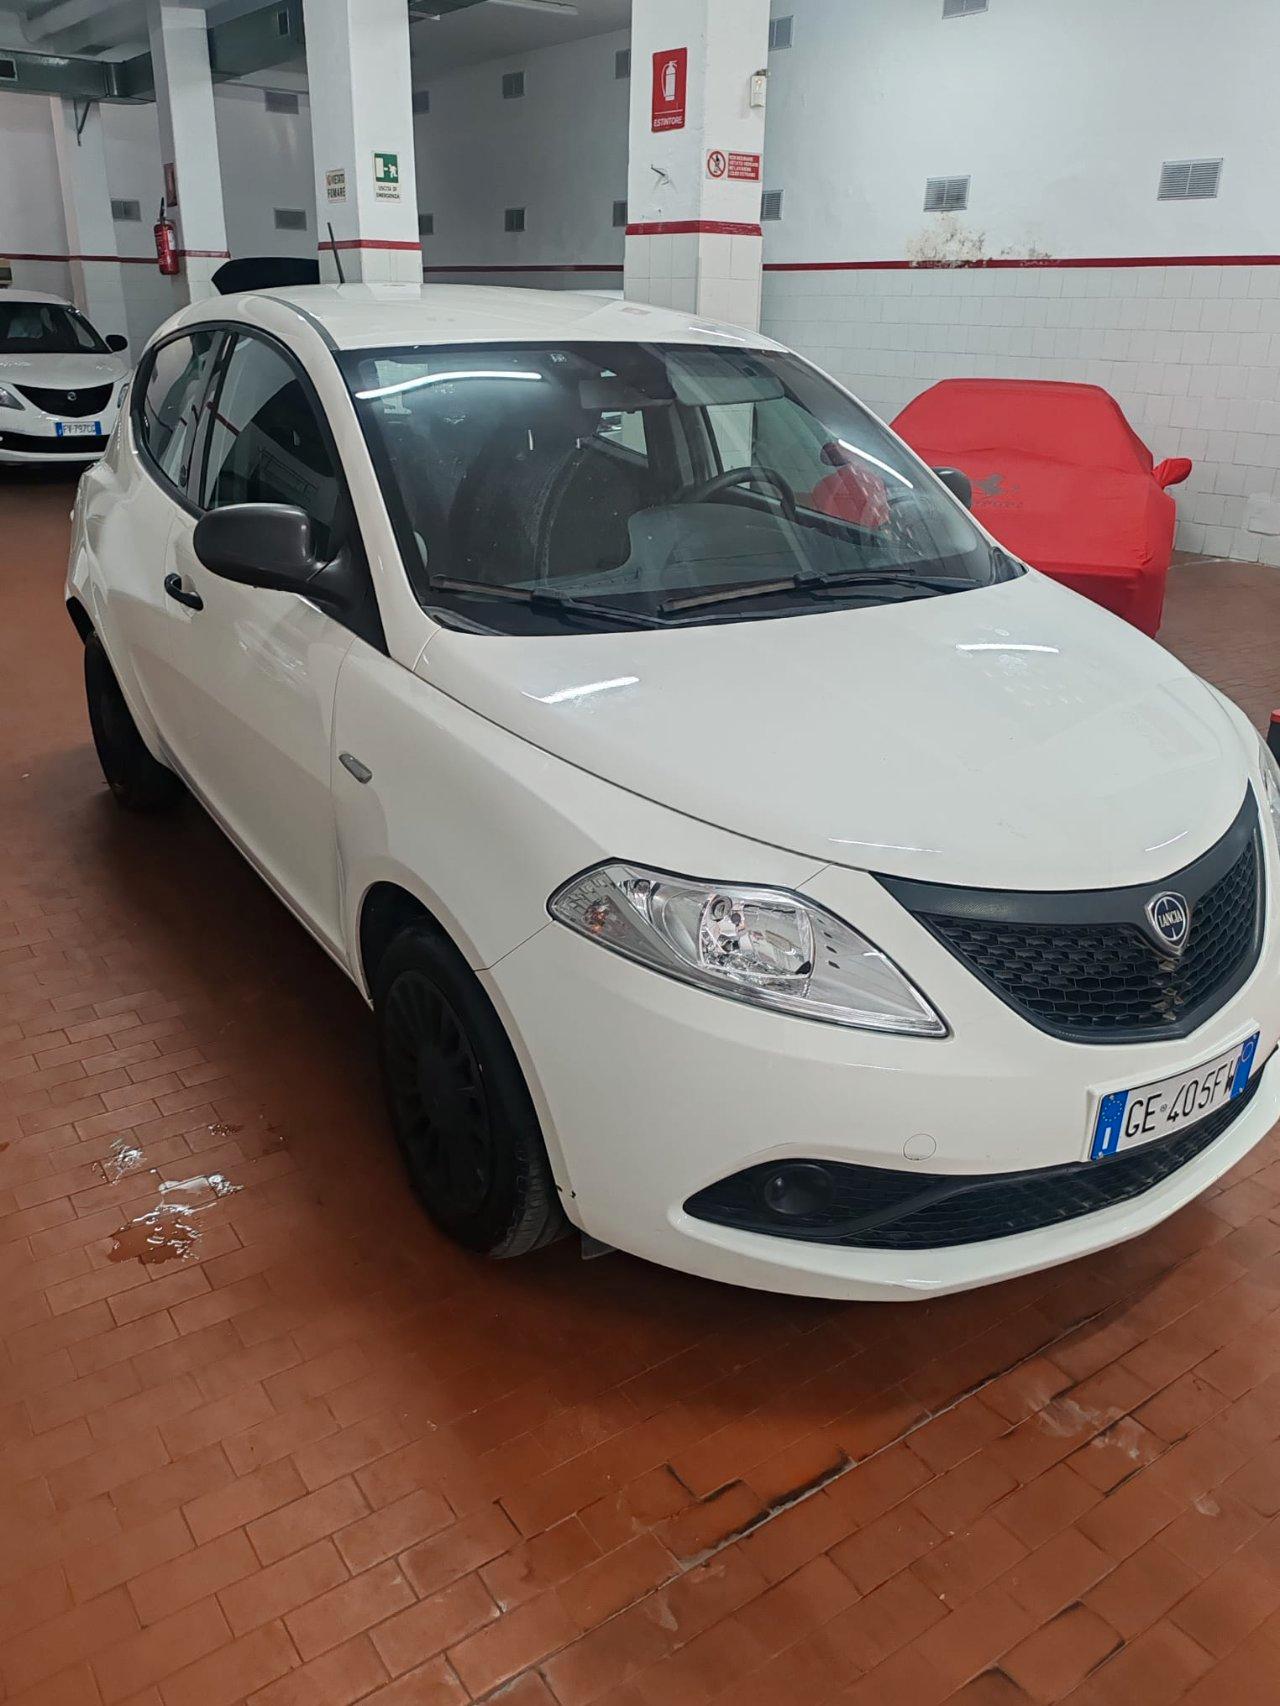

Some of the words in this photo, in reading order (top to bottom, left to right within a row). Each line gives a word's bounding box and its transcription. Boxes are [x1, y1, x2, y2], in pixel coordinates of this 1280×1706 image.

[653, 116, 682, 127] ESTINTORE
[327, 187, 345, 198] FUMARE
[1158, 910, 1182, 927] LANCIA
[1125, 1093, 1162, 1137] GE
